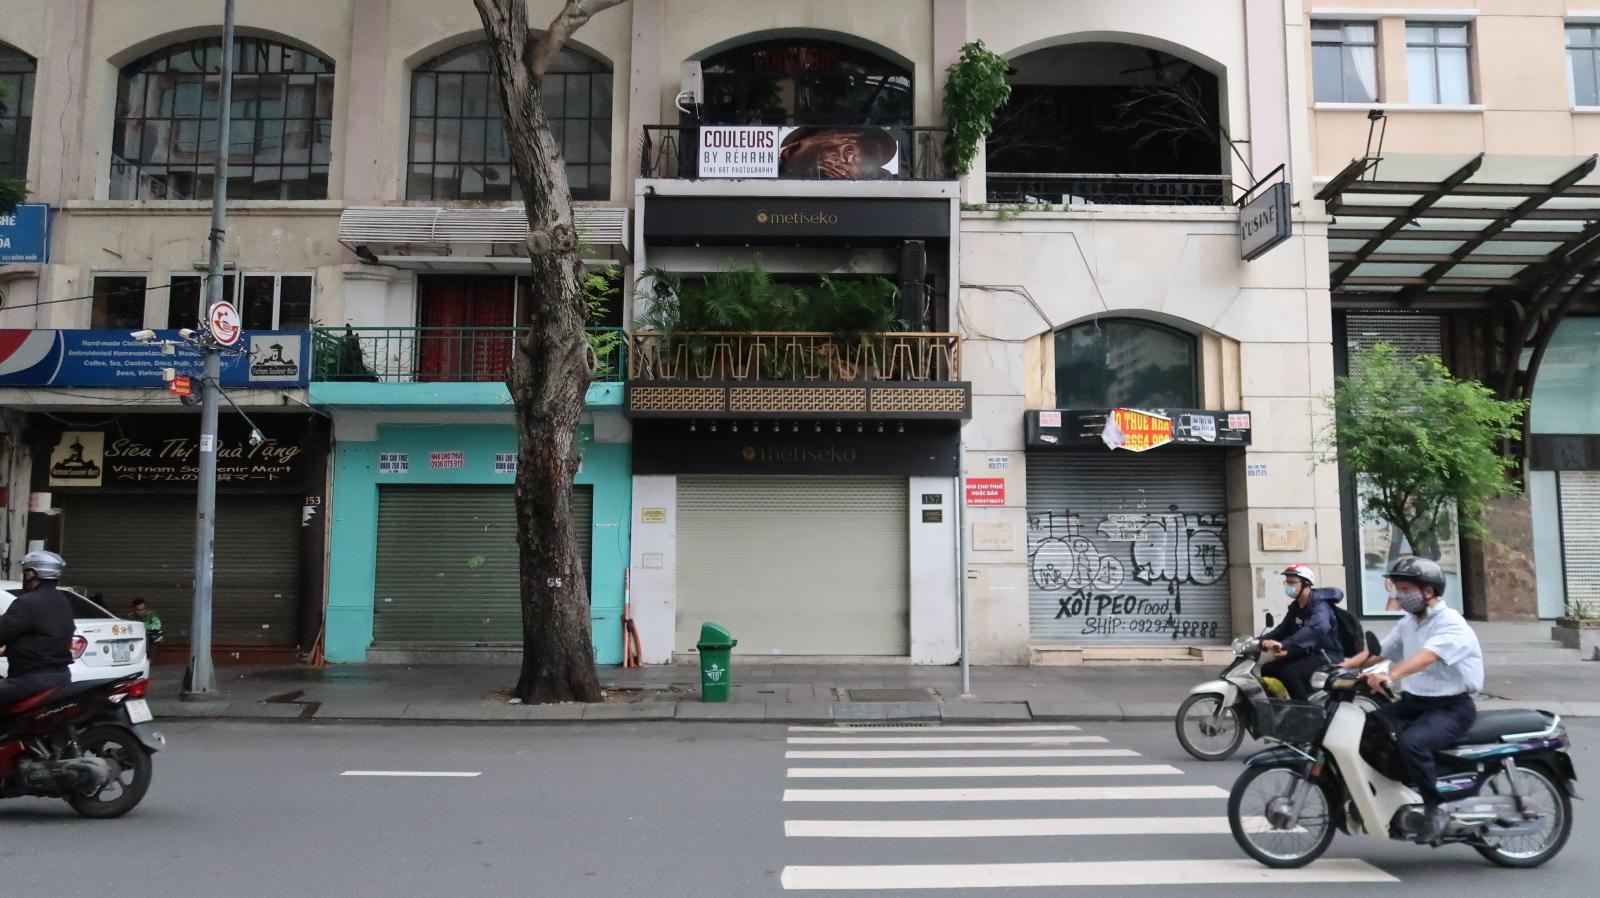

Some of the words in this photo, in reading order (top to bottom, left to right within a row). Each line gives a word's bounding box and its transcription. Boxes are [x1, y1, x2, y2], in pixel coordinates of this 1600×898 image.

[704, 130, 774, 148] COULEURS
[704, 151, 718, 163] BY
[725, 149, 774, 163] RÉHAHN
[770, 211, 838, 224] metiseko
[1242, 205, 1276, 240] L'USINE
[112, 464, 175, 472] Vietnam
[252, 465, 292, 473] Mart
[305, 496, 321, 505] 153
